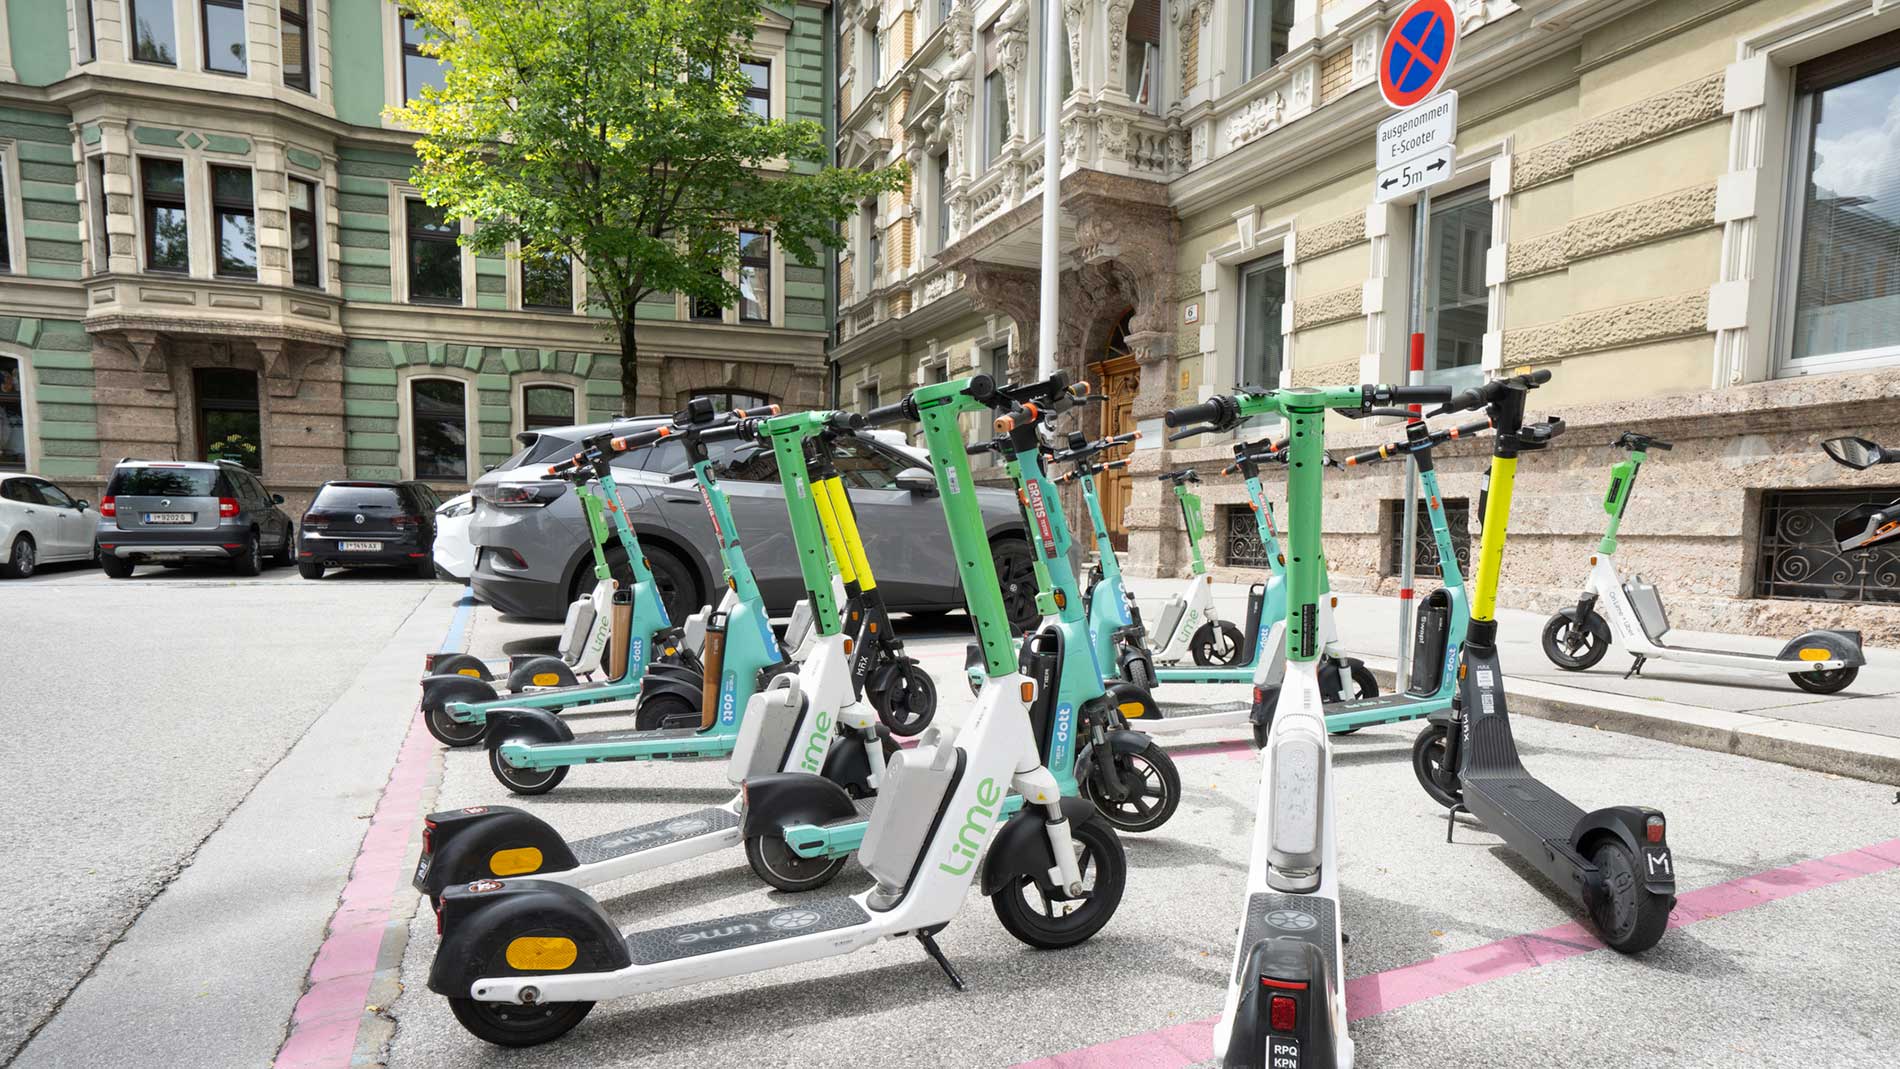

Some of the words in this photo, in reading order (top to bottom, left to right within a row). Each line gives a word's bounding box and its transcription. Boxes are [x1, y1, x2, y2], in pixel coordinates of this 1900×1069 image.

[1381, 103, 1449, 142] ausgenommen
[1391, 129, 1436, 158] E-Scooter
[1402, 166, 1423, 188] 5m
[1027, 482, 1046, 519] GRATIS
[592, 615, 609, 652] Lime
[1178, 609, 1199, 643] Lime
[633, 639, 641, 662] dott
[1447, 648, 1456, 671] dott
[723, 694, 735, 721] dott
[1057, 707, 1070, 742] dott
[801, 711, 831, 772] ime
[938, 777, 1000, 876] Lime
[1647, 853, 1670, 875] M
[675, 923, 760, 943] Lime
[1274, 1044, 1298, 1057] RPQ
[1274, 1057, 1298, 1069] KPN
